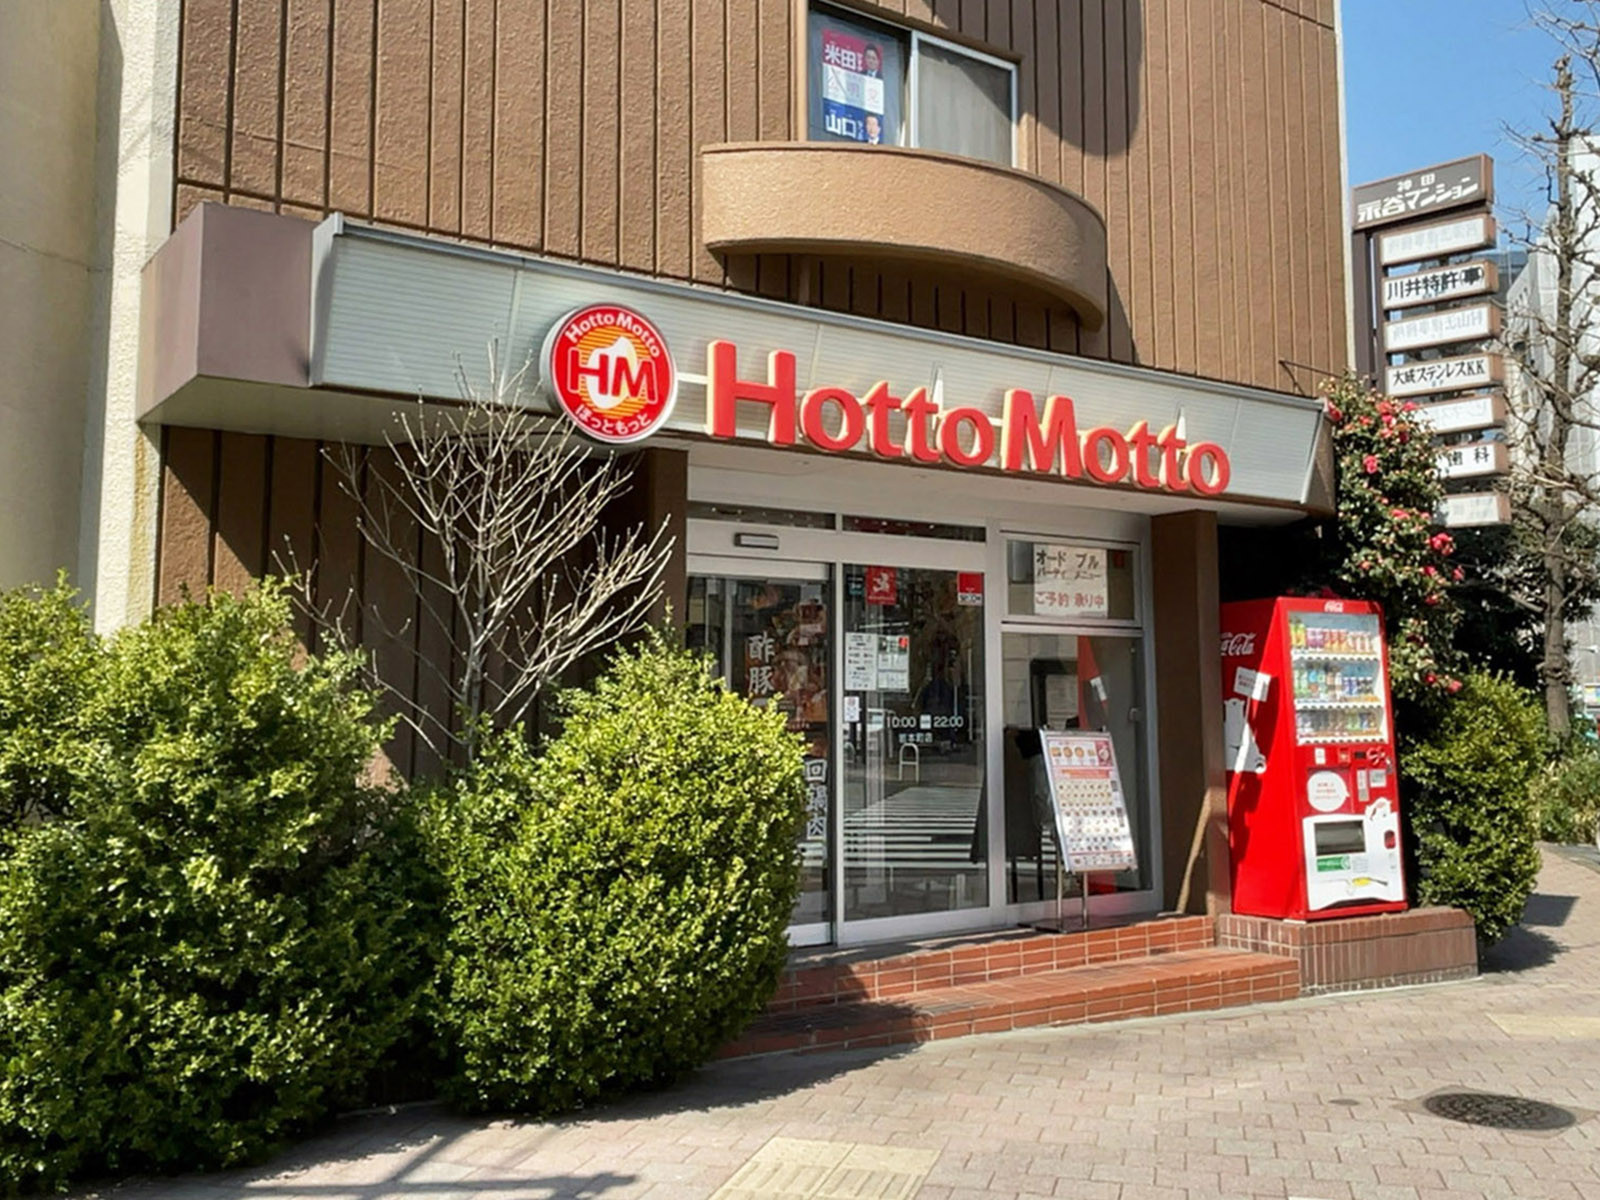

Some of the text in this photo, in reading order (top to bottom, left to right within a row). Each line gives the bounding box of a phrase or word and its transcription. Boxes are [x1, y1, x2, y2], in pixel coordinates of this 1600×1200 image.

[824, 43, 857, 71] 米田
[825, 114, 857, 139] 山口
[565, 312, 660, 358] Hotto Motto
[567, 346, 658, 405] HM
[749, 632, 775, 695] 酢豚
